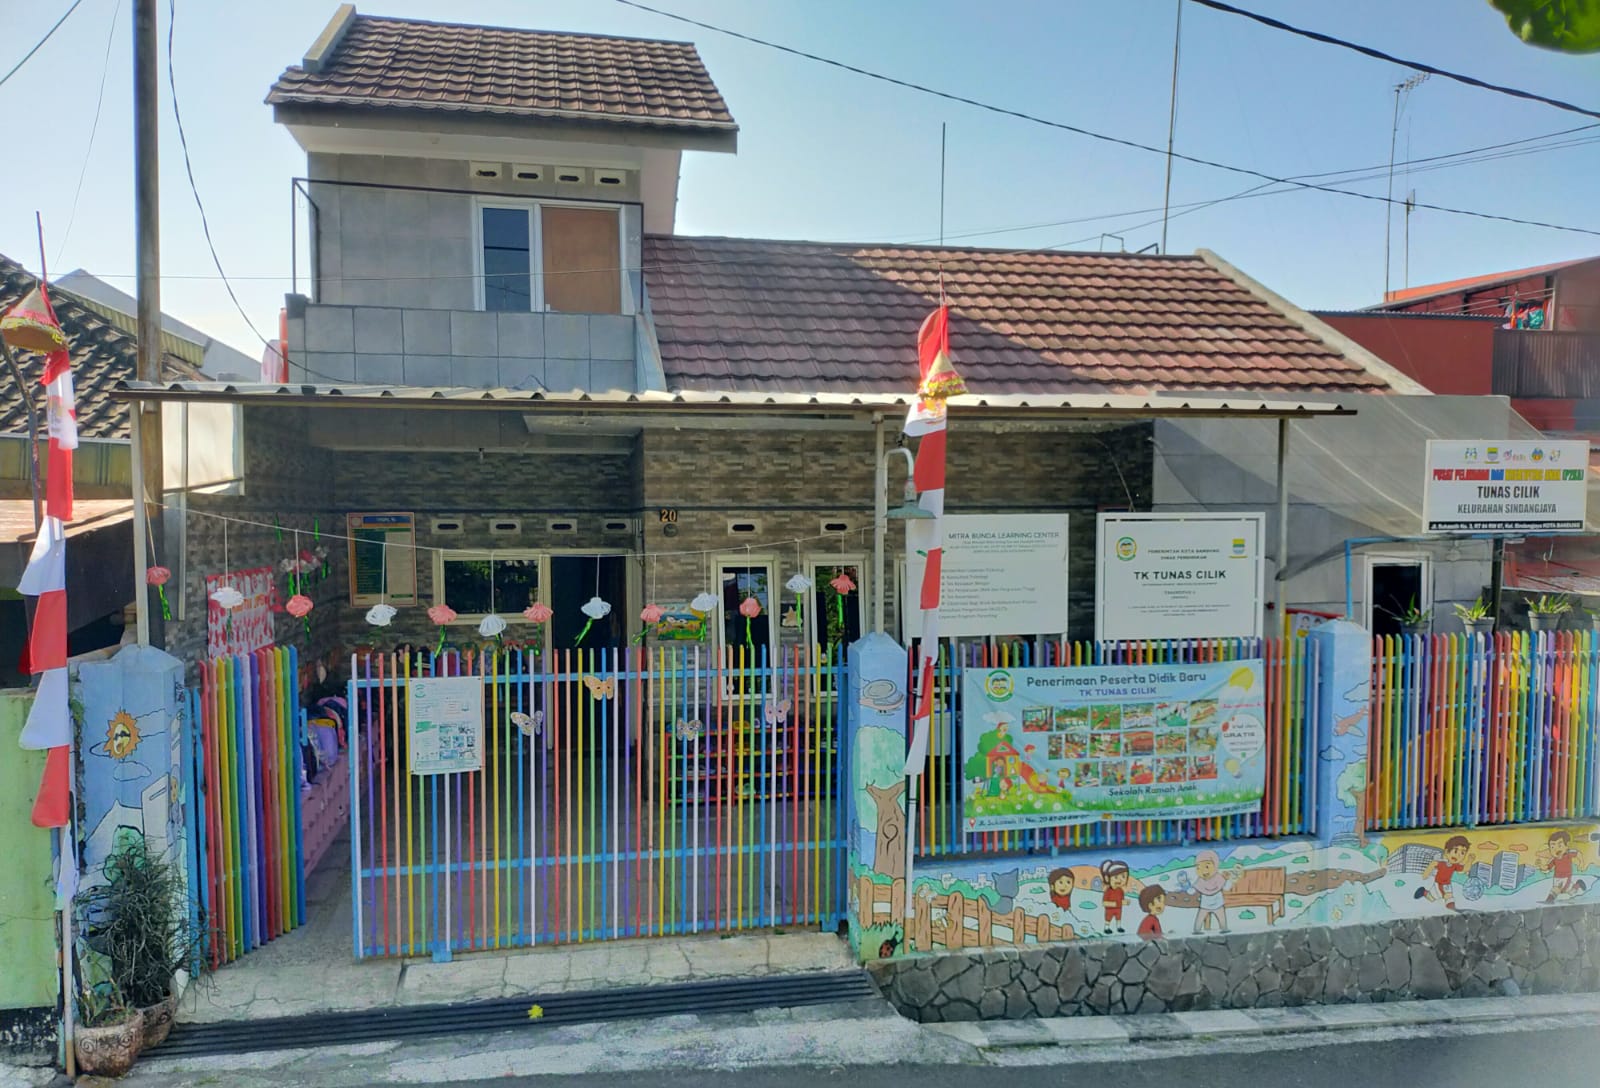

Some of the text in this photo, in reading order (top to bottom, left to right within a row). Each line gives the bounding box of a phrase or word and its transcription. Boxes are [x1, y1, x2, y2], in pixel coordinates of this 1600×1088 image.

[1477, 485, 1540, 499] TUNAS CILIK
[1457, 502, 1557, 514] KELURAHAN SINDANGJAYA
[661, 509, 677, 522] 20
[948, 530, 1060, 540] MITRA BUNDA LEARNING CENTER
[1133, 570, 1227, 580] TK TUNAS CILIK
[1027, 671, 1207, 688] Penerimaan Peserta Didik Baru
[1079, 686, 1157, 697] TK TUNAS CILIK
[1108, 783, 1198, 797] Sekolah Ramah Anak
